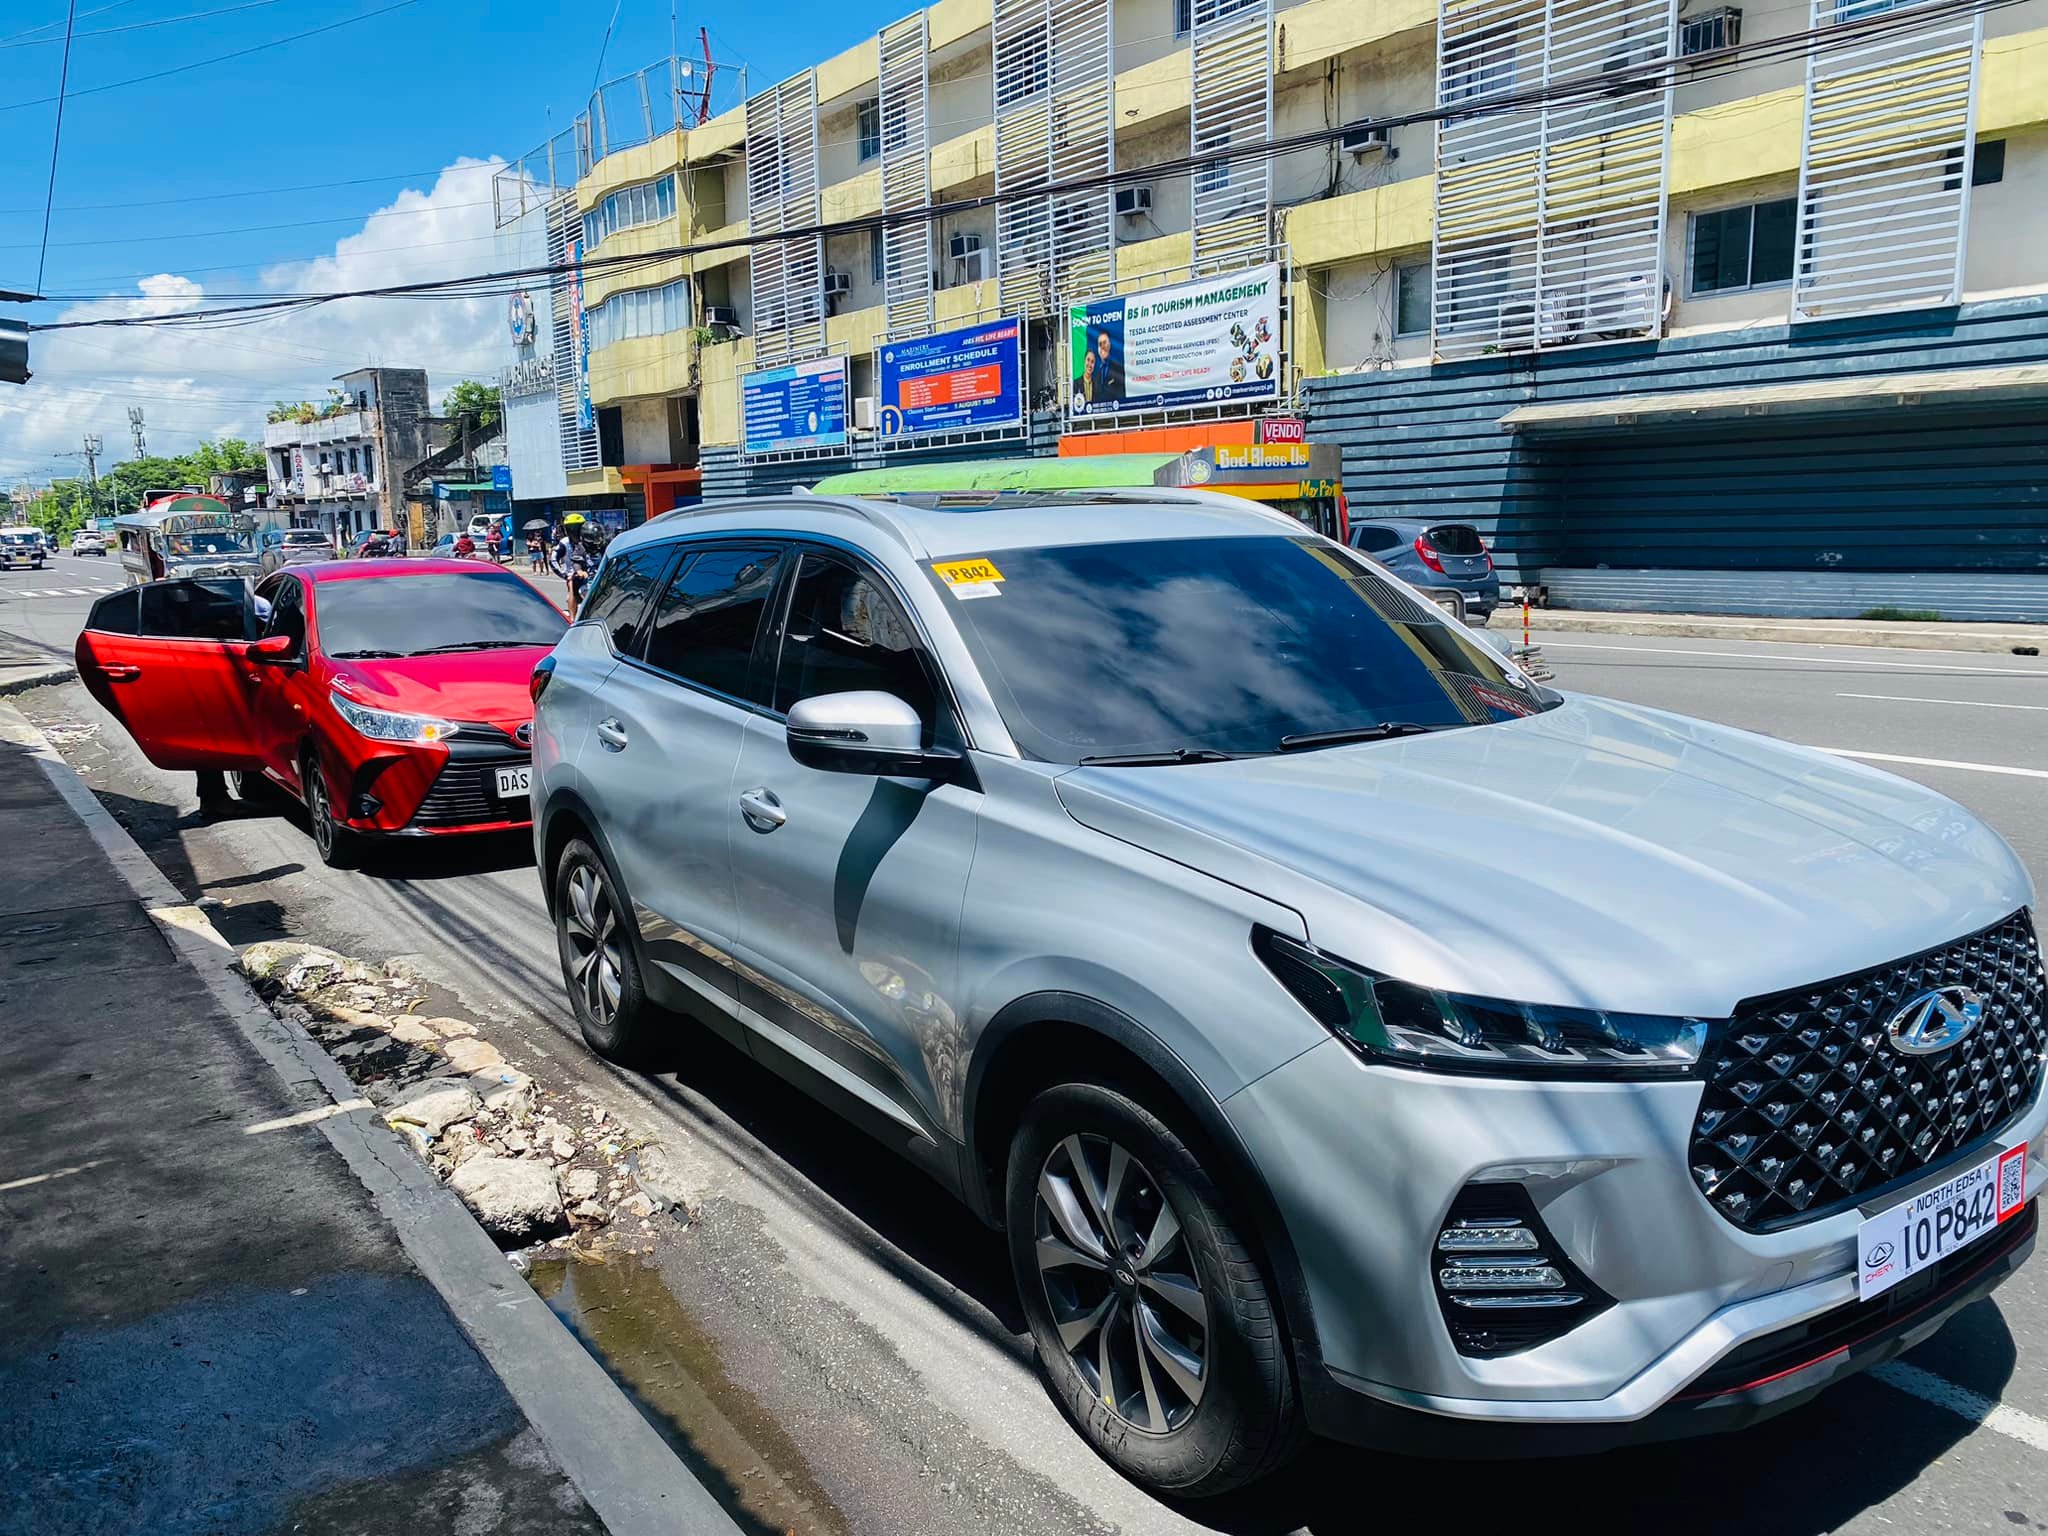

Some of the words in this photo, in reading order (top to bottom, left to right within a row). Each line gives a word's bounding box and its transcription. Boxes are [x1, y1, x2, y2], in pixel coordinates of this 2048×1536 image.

[1127, 308, 1138, 320] BS
[1141, 307, 1149, 317] in
[1151, 296, 1193, 315] TOURISM
[1194, 282, 1268, 307] MANAGEMENT
[1072, 316, 1091, 328] SOON
[1092, 314, 1102, 325] TO
[1103, 310, 1122, 323] OPEN
[1129, 327, 1146, 336] TESDA
[1147, 321, 1182, 333] ACCREDITED
[1183, 314, 1222, 326] ASSESSMENT
[1223, 309, 1249, 320] CENTER
[900, 355, 952, 373] ENROLLMENT
[952, 347, 998, 363] SCHEDULE
[958, 400, 981, 409] AUGUST
[1265, 423, 1301, 438] VENDO
[1219, 448, 1248, 469] God
[1250, 446, 1288, 467] Bless
[1290, 446, 1307, 466] Us
[500, 773, 529, 792] DAS
[1916, 1183, 1953, 1213] NORTH
[1955, 1168, 1982, 1193] EDSA
[1865, 1262, 1895, 1284] CHERY
